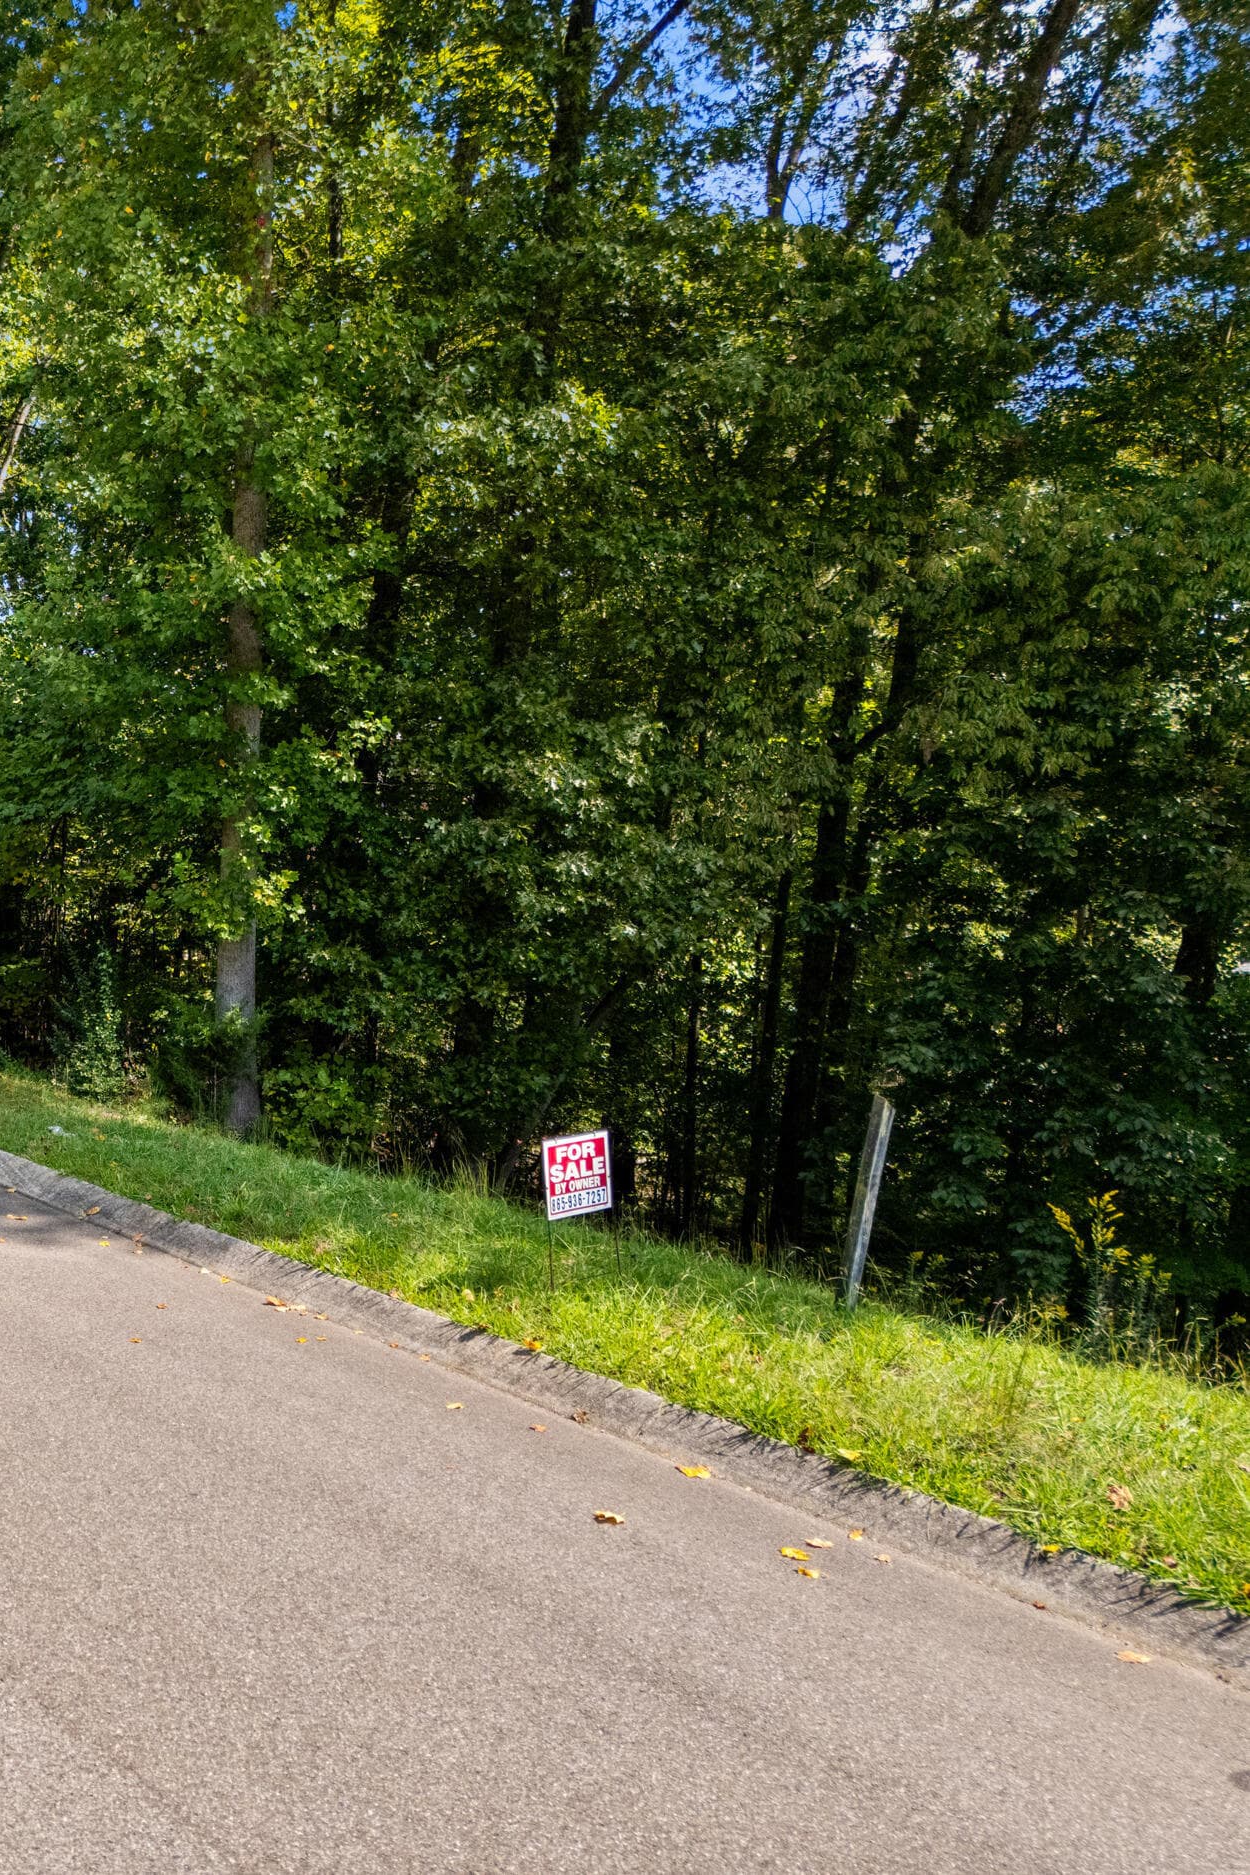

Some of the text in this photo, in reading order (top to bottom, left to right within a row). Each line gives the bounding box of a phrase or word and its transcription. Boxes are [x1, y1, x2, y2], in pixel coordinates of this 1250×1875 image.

[555, 1141, 596, 1164] FOR
[550, 1156, 605, 1183] SALE
[554, 1175, 601, 1195] BY OWNER
[551, 1188, 606, 1212] 865-936-7257
